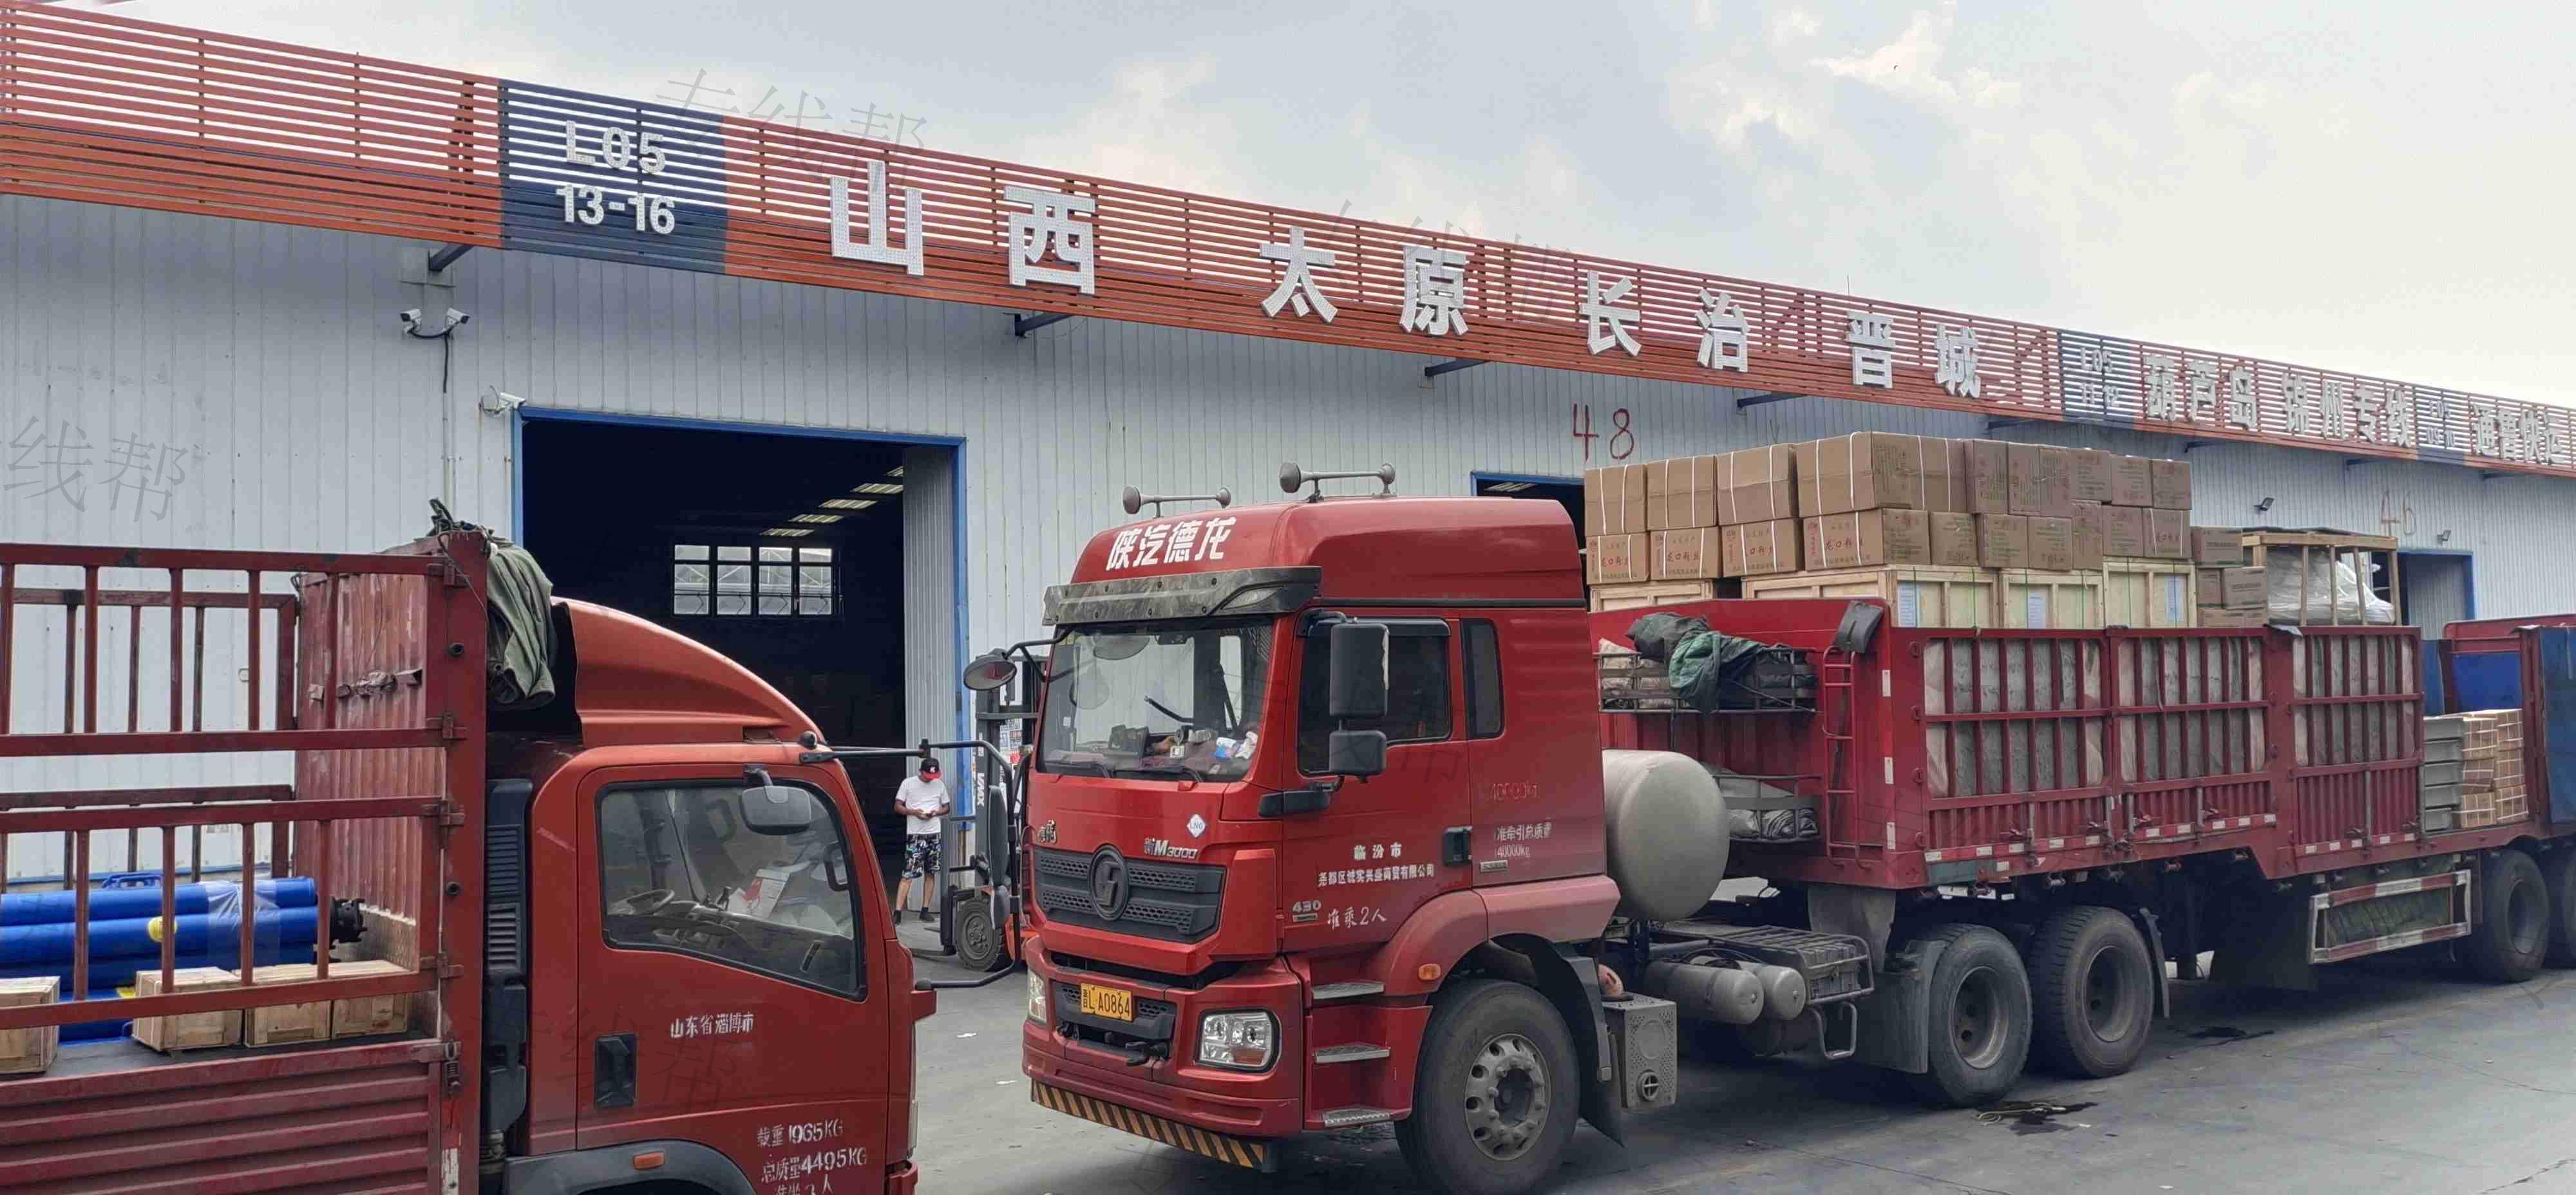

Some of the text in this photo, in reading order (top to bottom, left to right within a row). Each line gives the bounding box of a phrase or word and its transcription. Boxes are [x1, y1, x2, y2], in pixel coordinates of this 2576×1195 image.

[556, 183, 676, 235] 13-16
[830, 161, 1095, 295] 山西
[1258, 226, 1469, 336] 太原
[1579, 270, 1750, 373] 长治
[1846, 309, 1982, 399] 晋城
[2143, 354, 2257, 431] 葫芦岛
[1573, 402, 1635, 462] 48
[2380, 489, 2418, 536] 46
[1105, 516, 1237, 571] 陕汽德龙
[1354, 842, 1402, 860] 临汾市
[1292, 899, 1322, 913] 430
[1327, 906, 1387, 930] 准乘2人
[670, 1011, 754, 1039] 山东省淄博市
[757, 1124, 784, 1148] 载重
